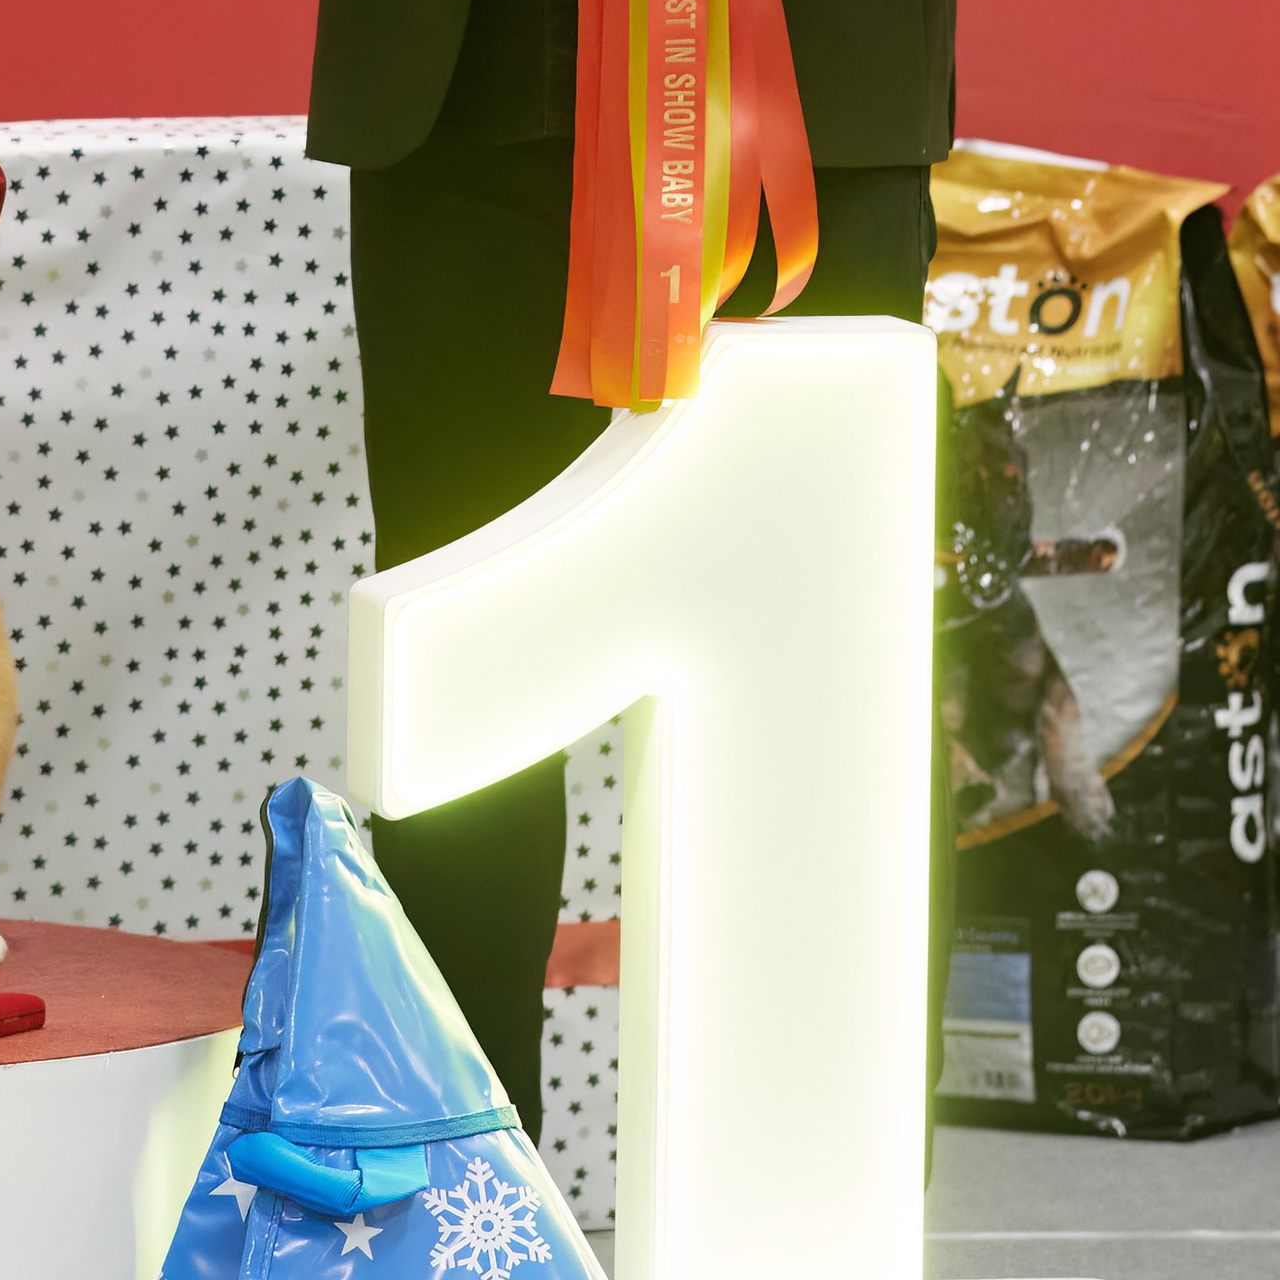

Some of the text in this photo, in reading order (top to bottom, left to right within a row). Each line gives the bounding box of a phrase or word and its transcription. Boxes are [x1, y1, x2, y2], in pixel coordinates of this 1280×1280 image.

[664, 38, 696, 63] IN
[663, 73, 696, 150] SHOW
[660, 160, 695, 225] BABY
[659, 264, 681, 304] 1
[925, 265, 1131, 337] ston
[349, 316, 936, 1280] 1
